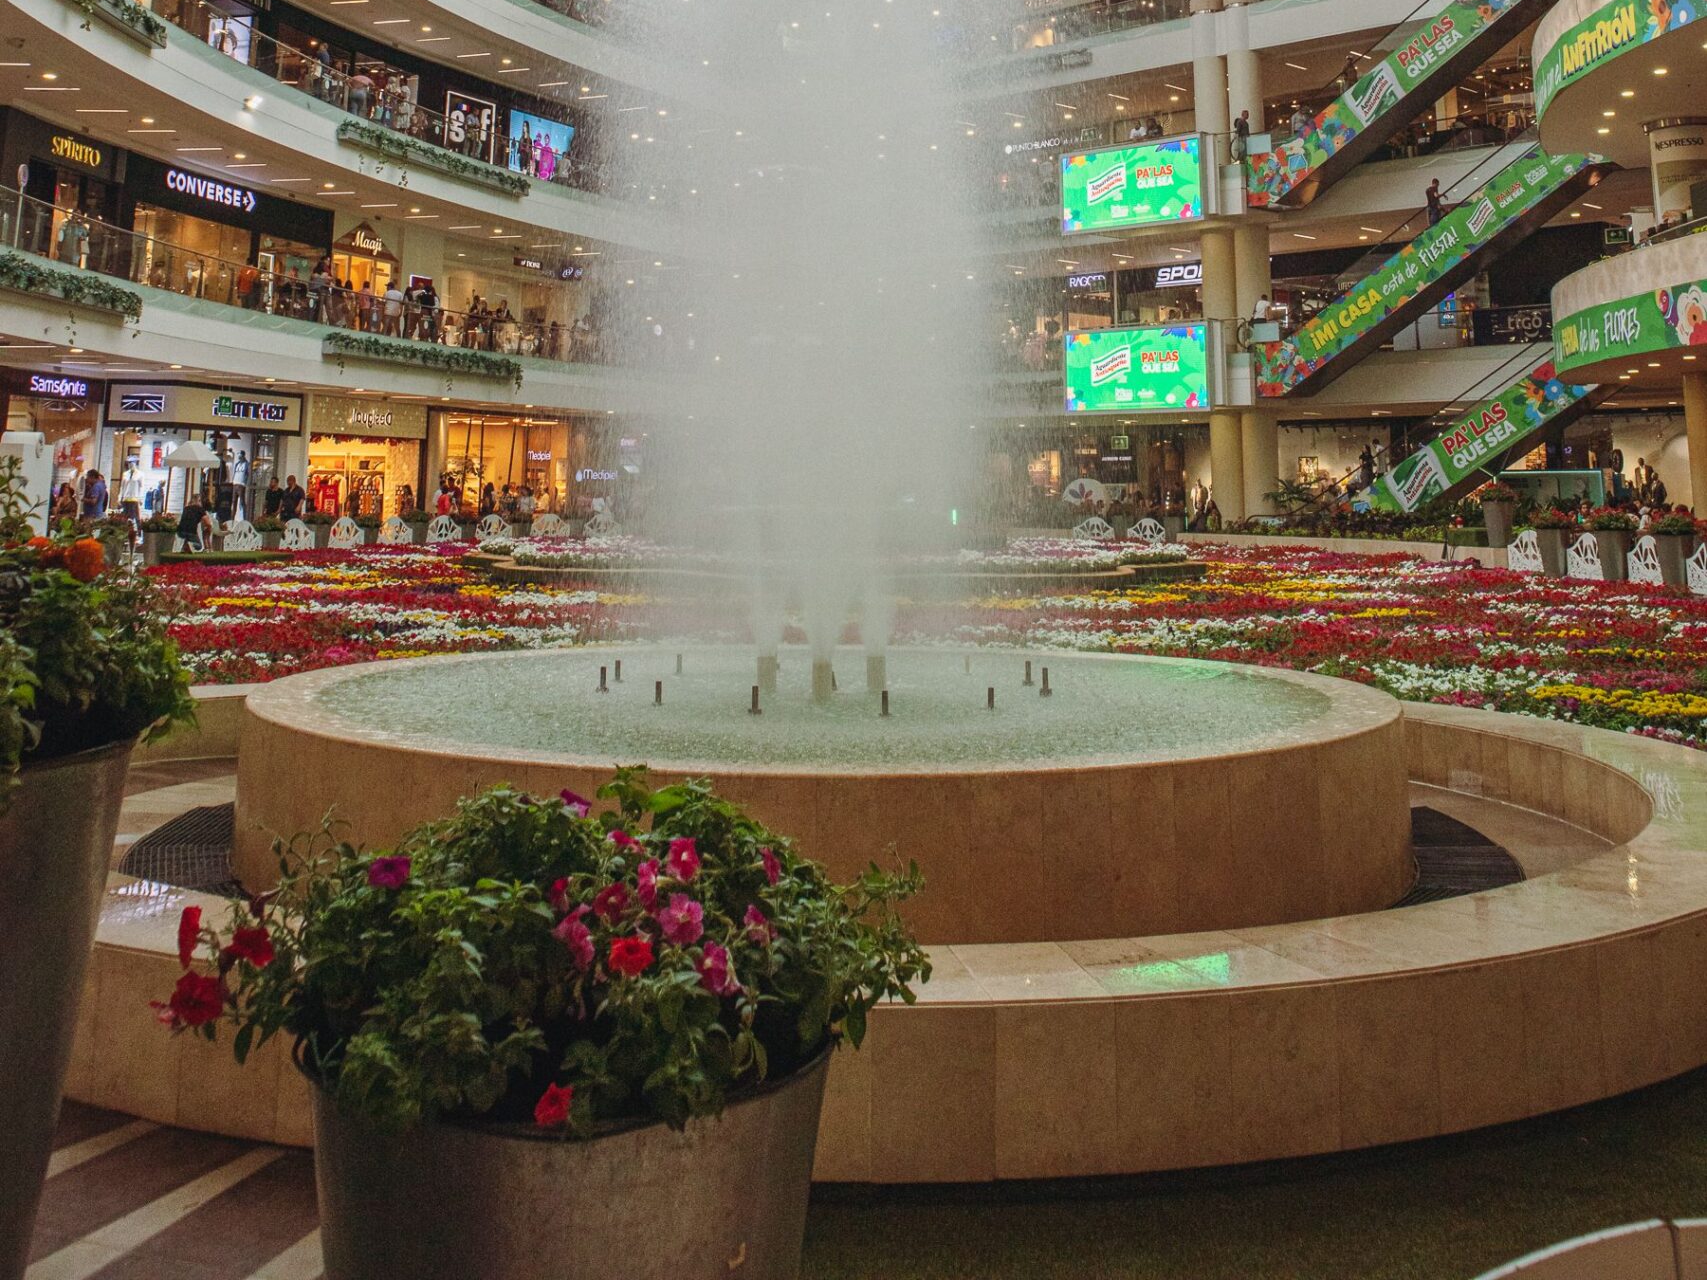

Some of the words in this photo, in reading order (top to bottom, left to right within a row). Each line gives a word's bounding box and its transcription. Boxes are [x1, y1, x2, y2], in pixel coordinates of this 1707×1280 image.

[1421, 15, 1455, 48] LAS
[1407, 48, 1438, 78] QUE
[1434, 29, 1463, 55] SEA
[1655, 137, 1704, 151] NESPRESSO
[1136, 177, 1156, 189] QUE
[1157, 175, 1174, 188] SEA
[1153, 165, 1173, 177] LAS
[167, 170, 242, 207] CONVERSE
[352, 230, 383, 256] Maaji
[1069, 275, 1106, 288] RAGG
[1156, 264, 1202, 282] SPO
[1339, 288, 1383, 328] CASA
[1382, 271, 1406, 296] está
[1405, 260, 1419, 279] de
[1418, 226, 1460, 268] FIESTA!
[1604, 307, 1641, 348] FLORES
[1141, 363, 1161, 374] QUE
[1162, 361, 1180, 373] SEA
[1158, 350, 1179, 362] LAS
[30, 376, 87, 397] Samsonite
[1441, 425, 1471, 456] PA'
[1468, 402, 1507, 437] LAS
[1453, 438, 1488, 469] QUE
[1484, 420, 1517, 448] SEA
